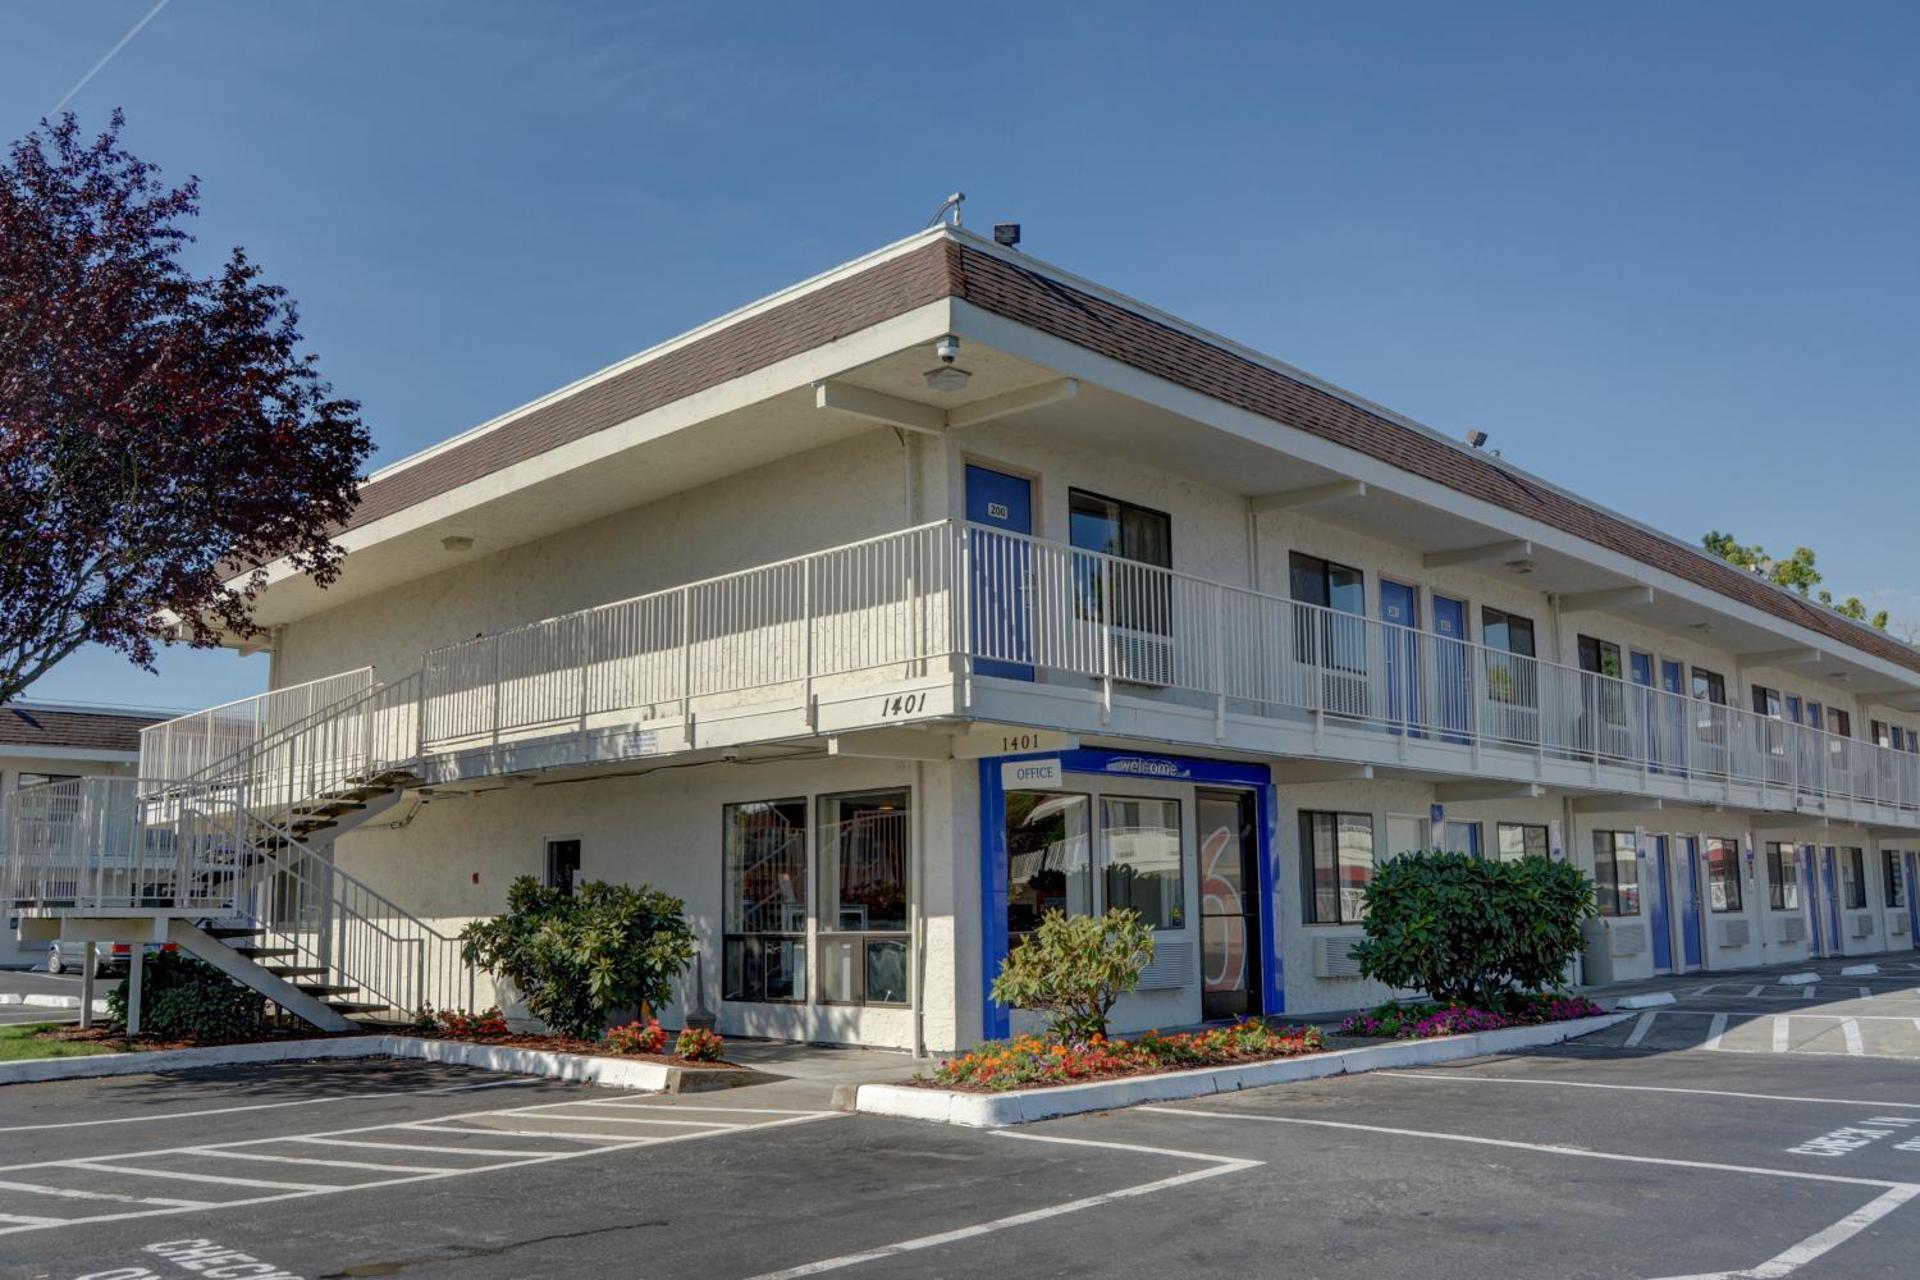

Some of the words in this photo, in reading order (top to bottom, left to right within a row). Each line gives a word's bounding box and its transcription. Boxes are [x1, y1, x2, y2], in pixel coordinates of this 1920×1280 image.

[881, 692, 927, 717] 1401
[1002, 734, 1039, 751] 1401
[1016, 766, 1054, 781] OFFICE
[1119, 757, 1178, 777] welcome
[1784, 1126, 1895, 1156] CHECK
